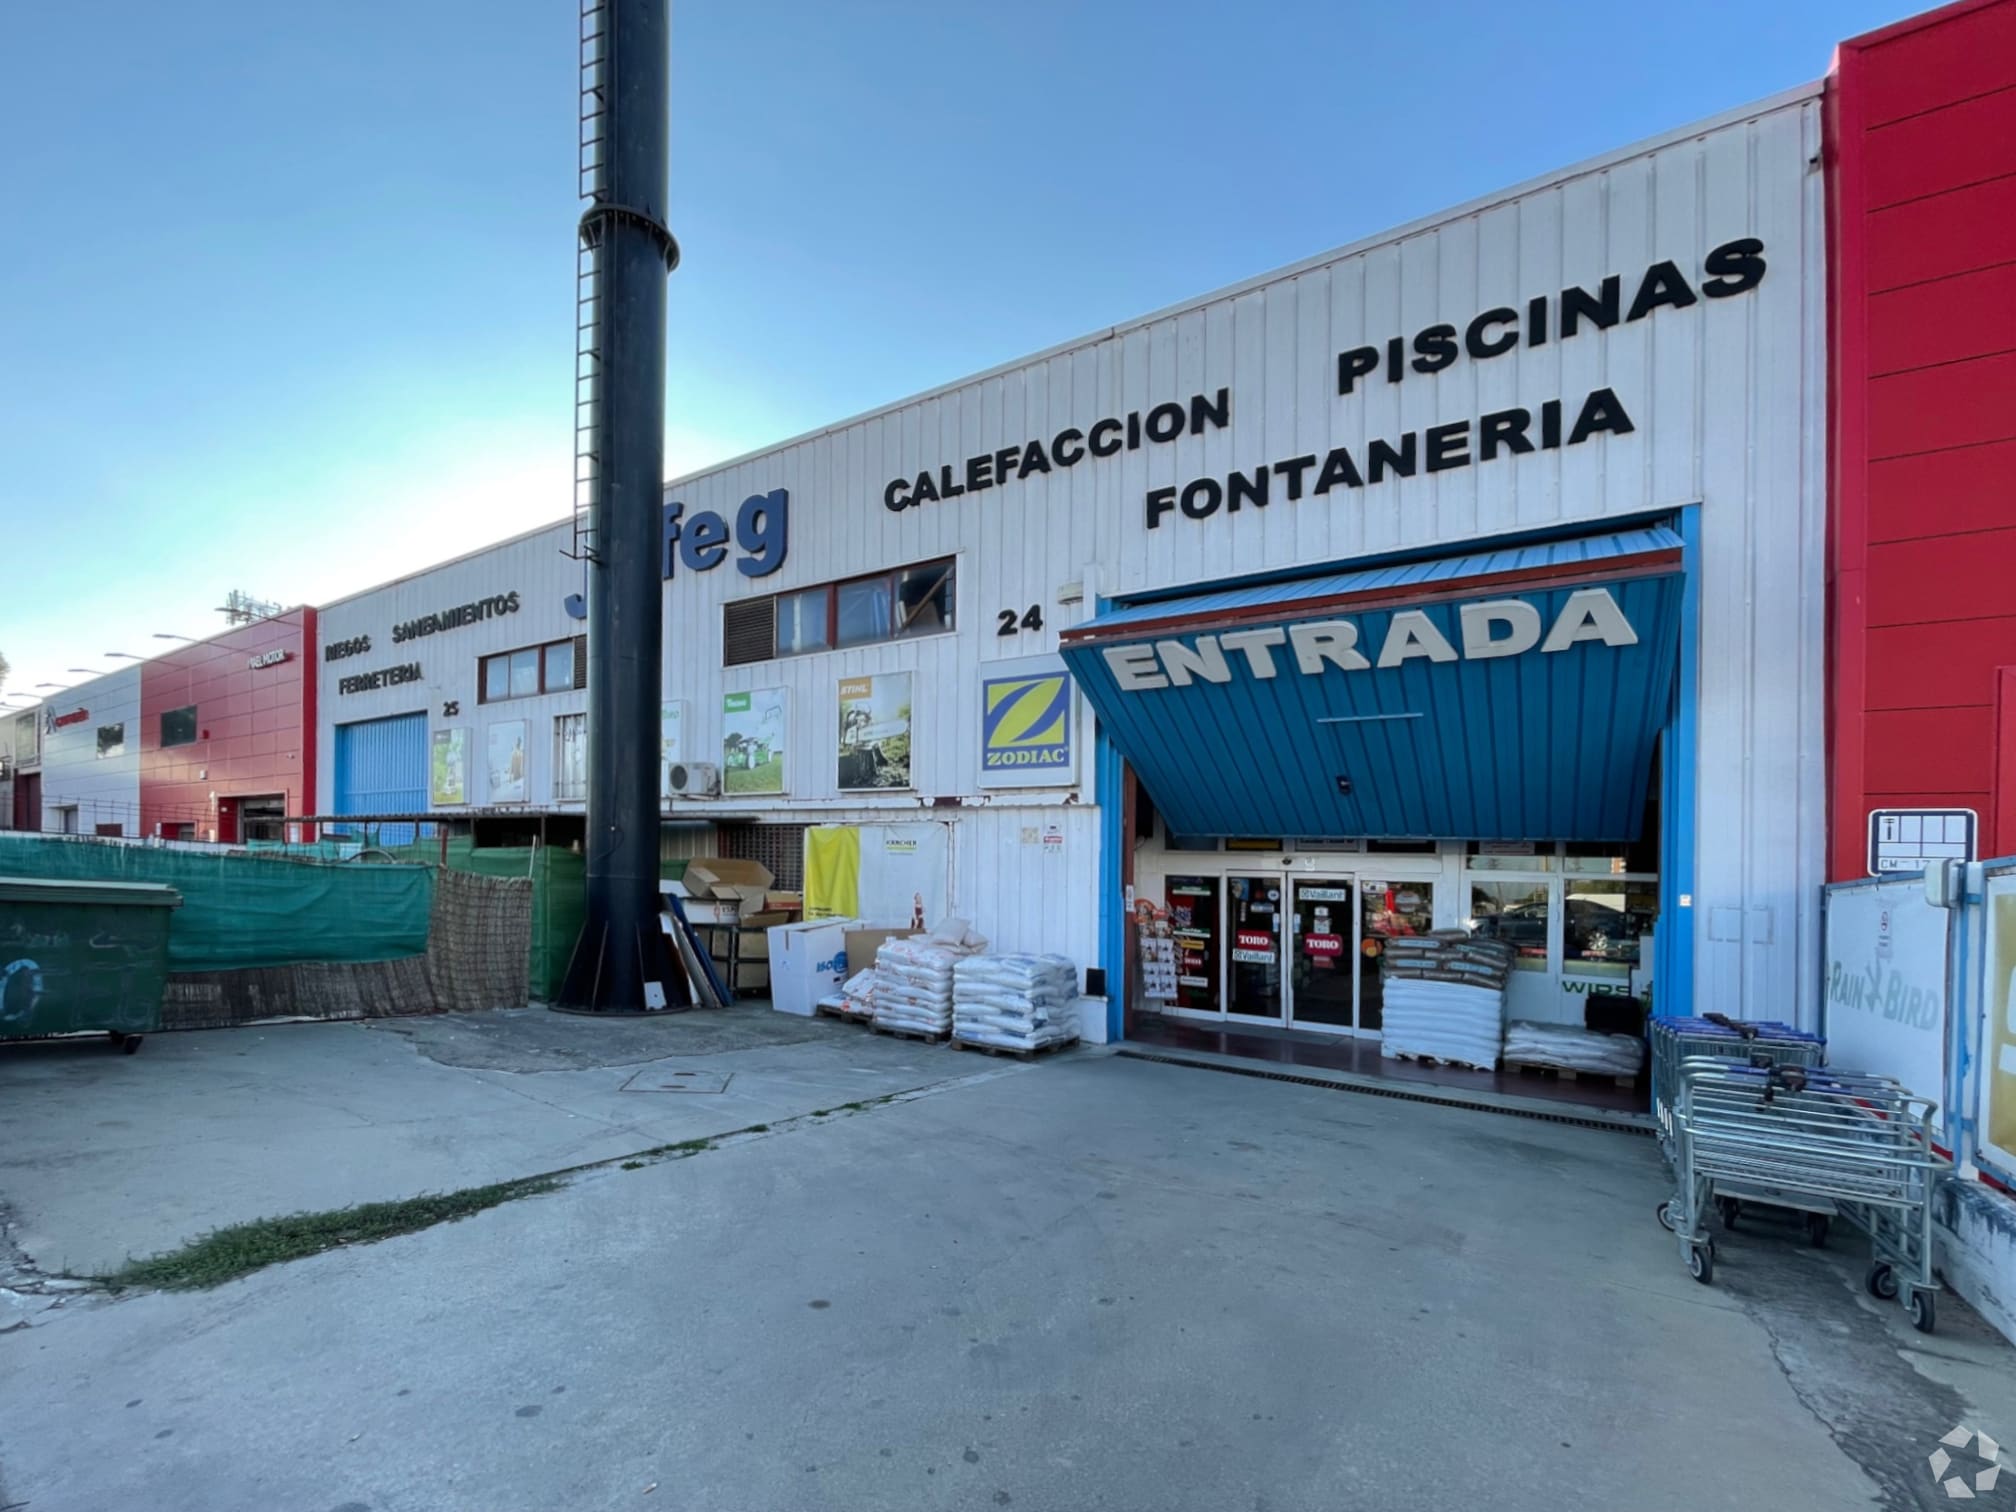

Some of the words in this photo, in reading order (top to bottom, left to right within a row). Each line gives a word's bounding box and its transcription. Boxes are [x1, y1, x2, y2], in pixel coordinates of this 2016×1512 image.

[1338, 237, 1767, 395] PISCINAS
[884, 387, 1229, 512] CALEFACCION
[1146, 387, 1635, 528] FONTANERIA
[392, 590, 520, 644] SANEAMIENTOS
[997, 604, 1043, 636] 24
[1102, 587, 1638, 691] ENTRADA
[339, 662, 424, 695] FERRETERIA
[443, 701, 459, 717] 25
[1239, 935, 1269, 946] TORO
[1306, 939, 1339, 950] TORO
